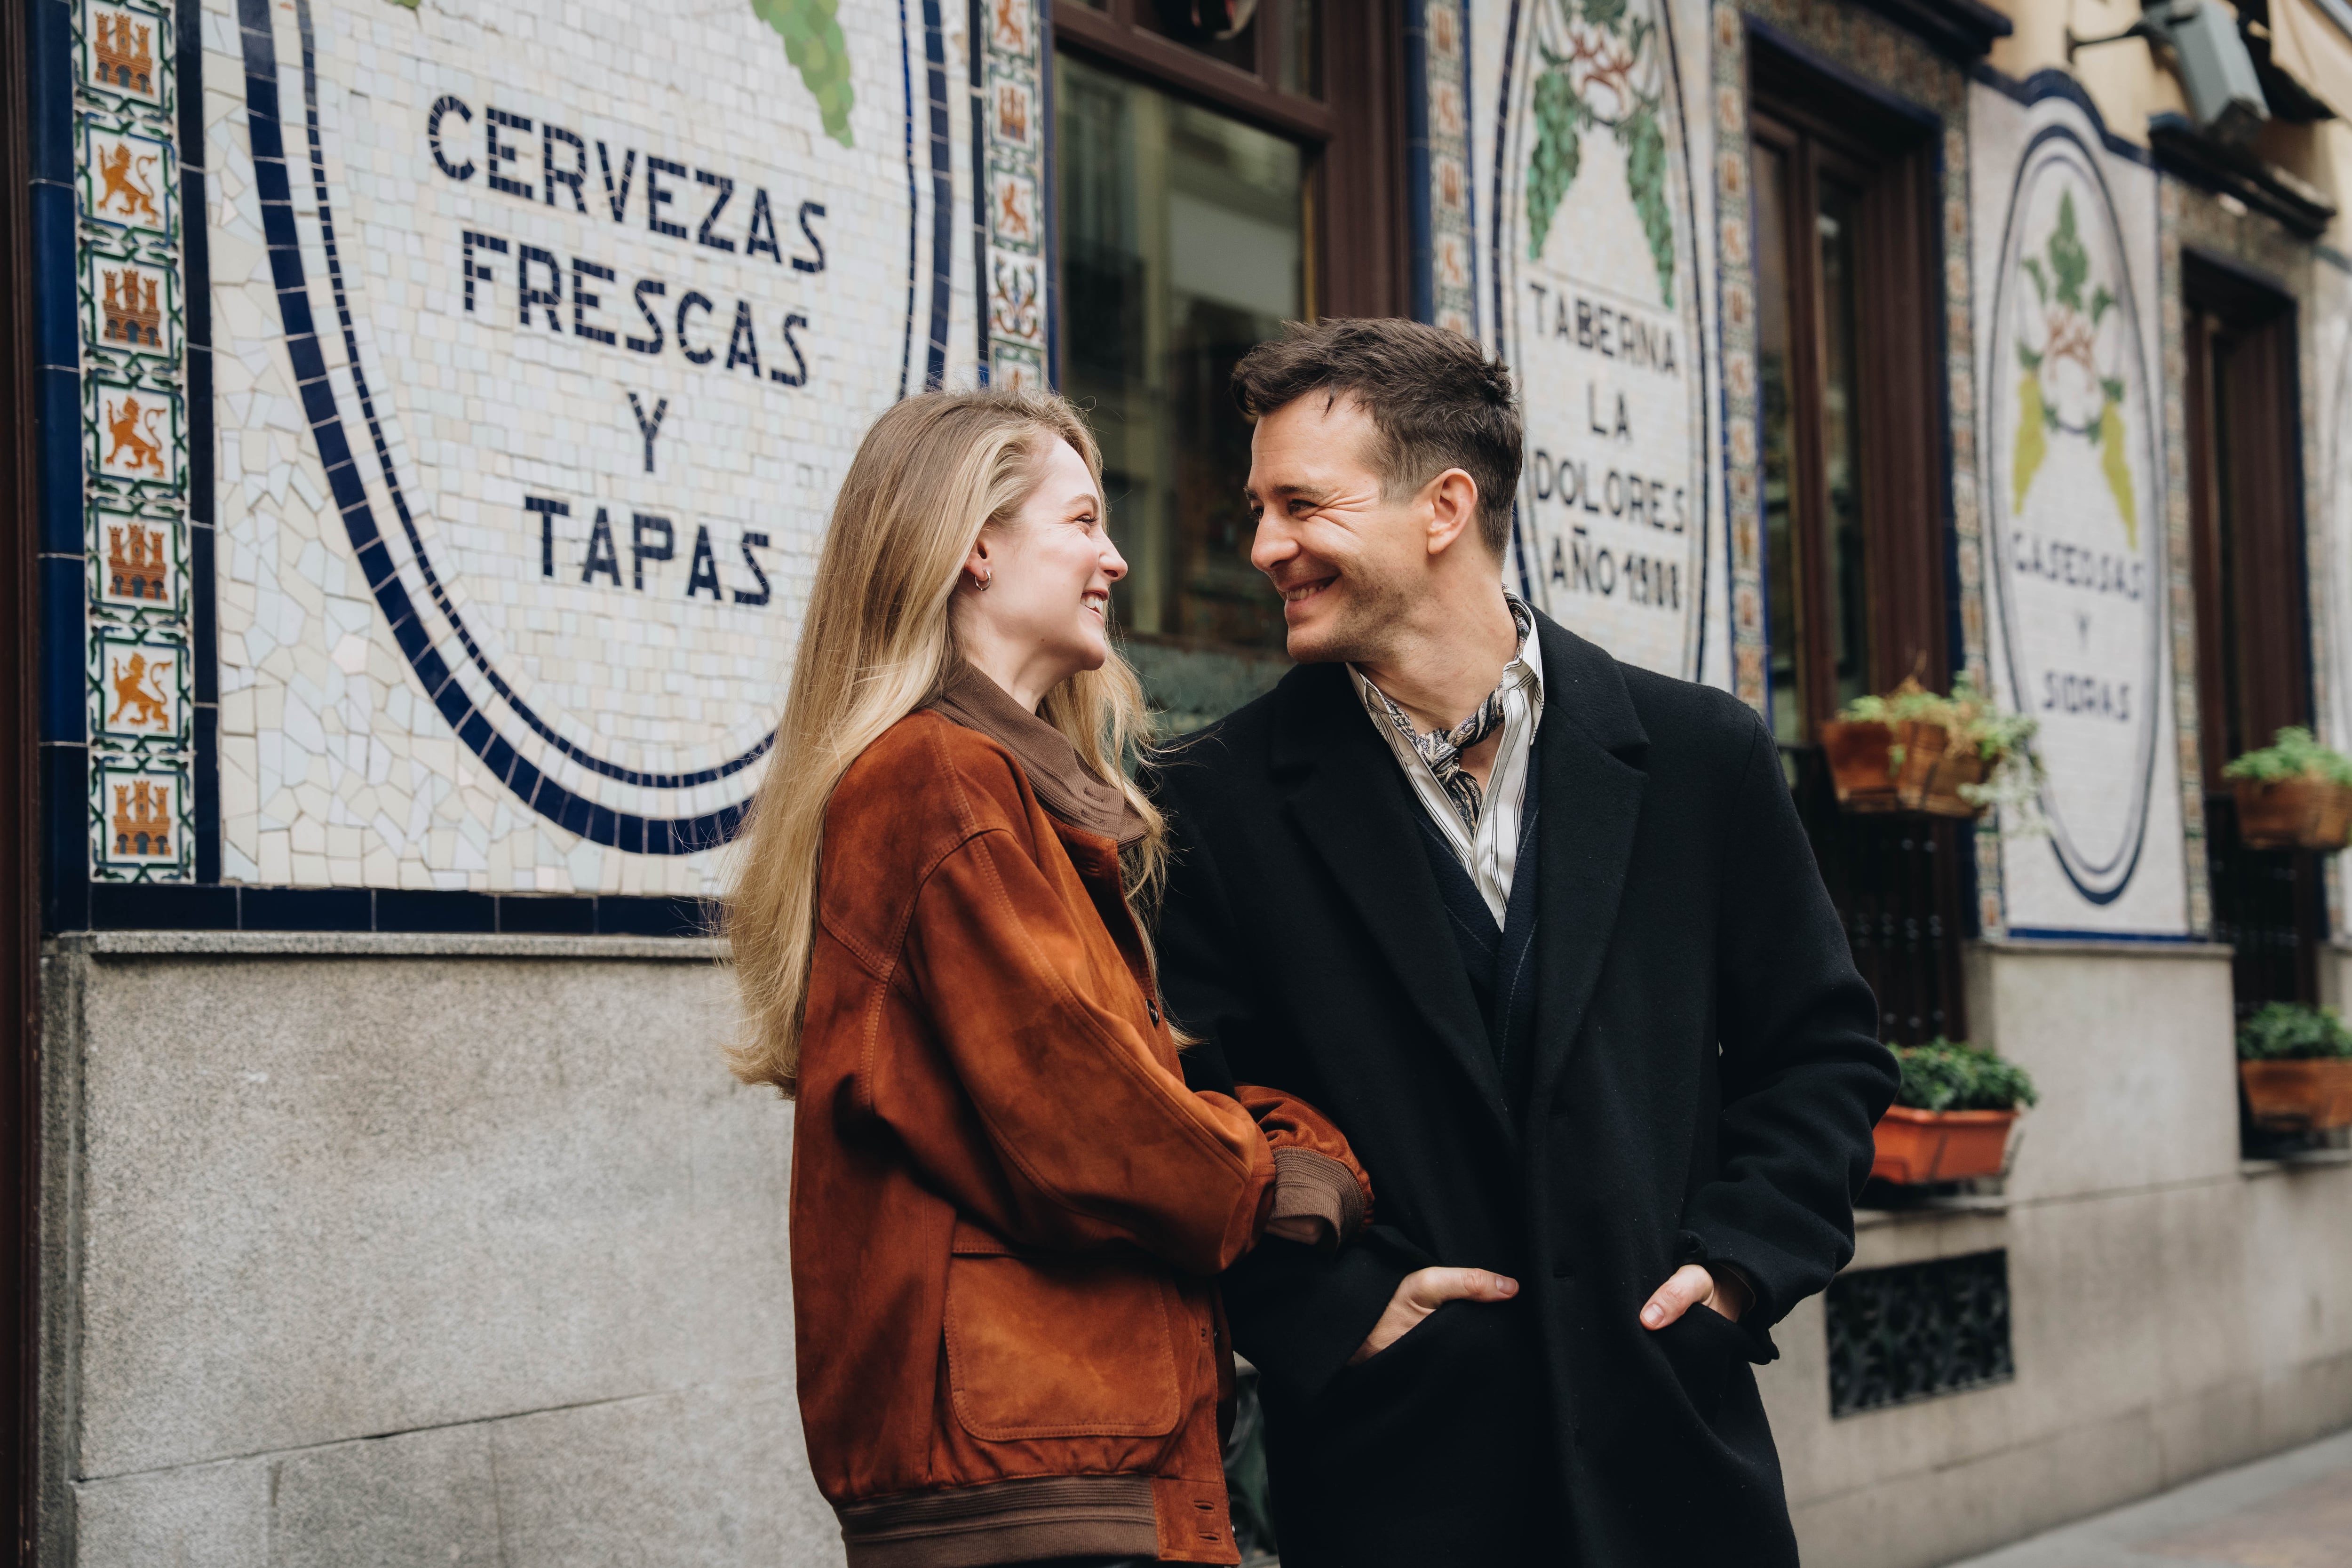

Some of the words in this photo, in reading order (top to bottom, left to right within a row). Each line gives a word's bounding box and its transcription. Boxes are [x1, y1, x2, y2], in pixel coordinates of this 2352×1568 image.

[429, 95, 826, 273] CERVEZAS
[462, 230, 808, 387] FRESCAS
[1530, 282, 1678, 373] TABERNA
[627, 392, 667, 472] Y
[1588, 382, 1632, 441] LA
[1534, 450, 1685, 533] DOLORES
[525, 496, 770, 606] TAPAS
[1552, 526, 1616, 595] AÑO
